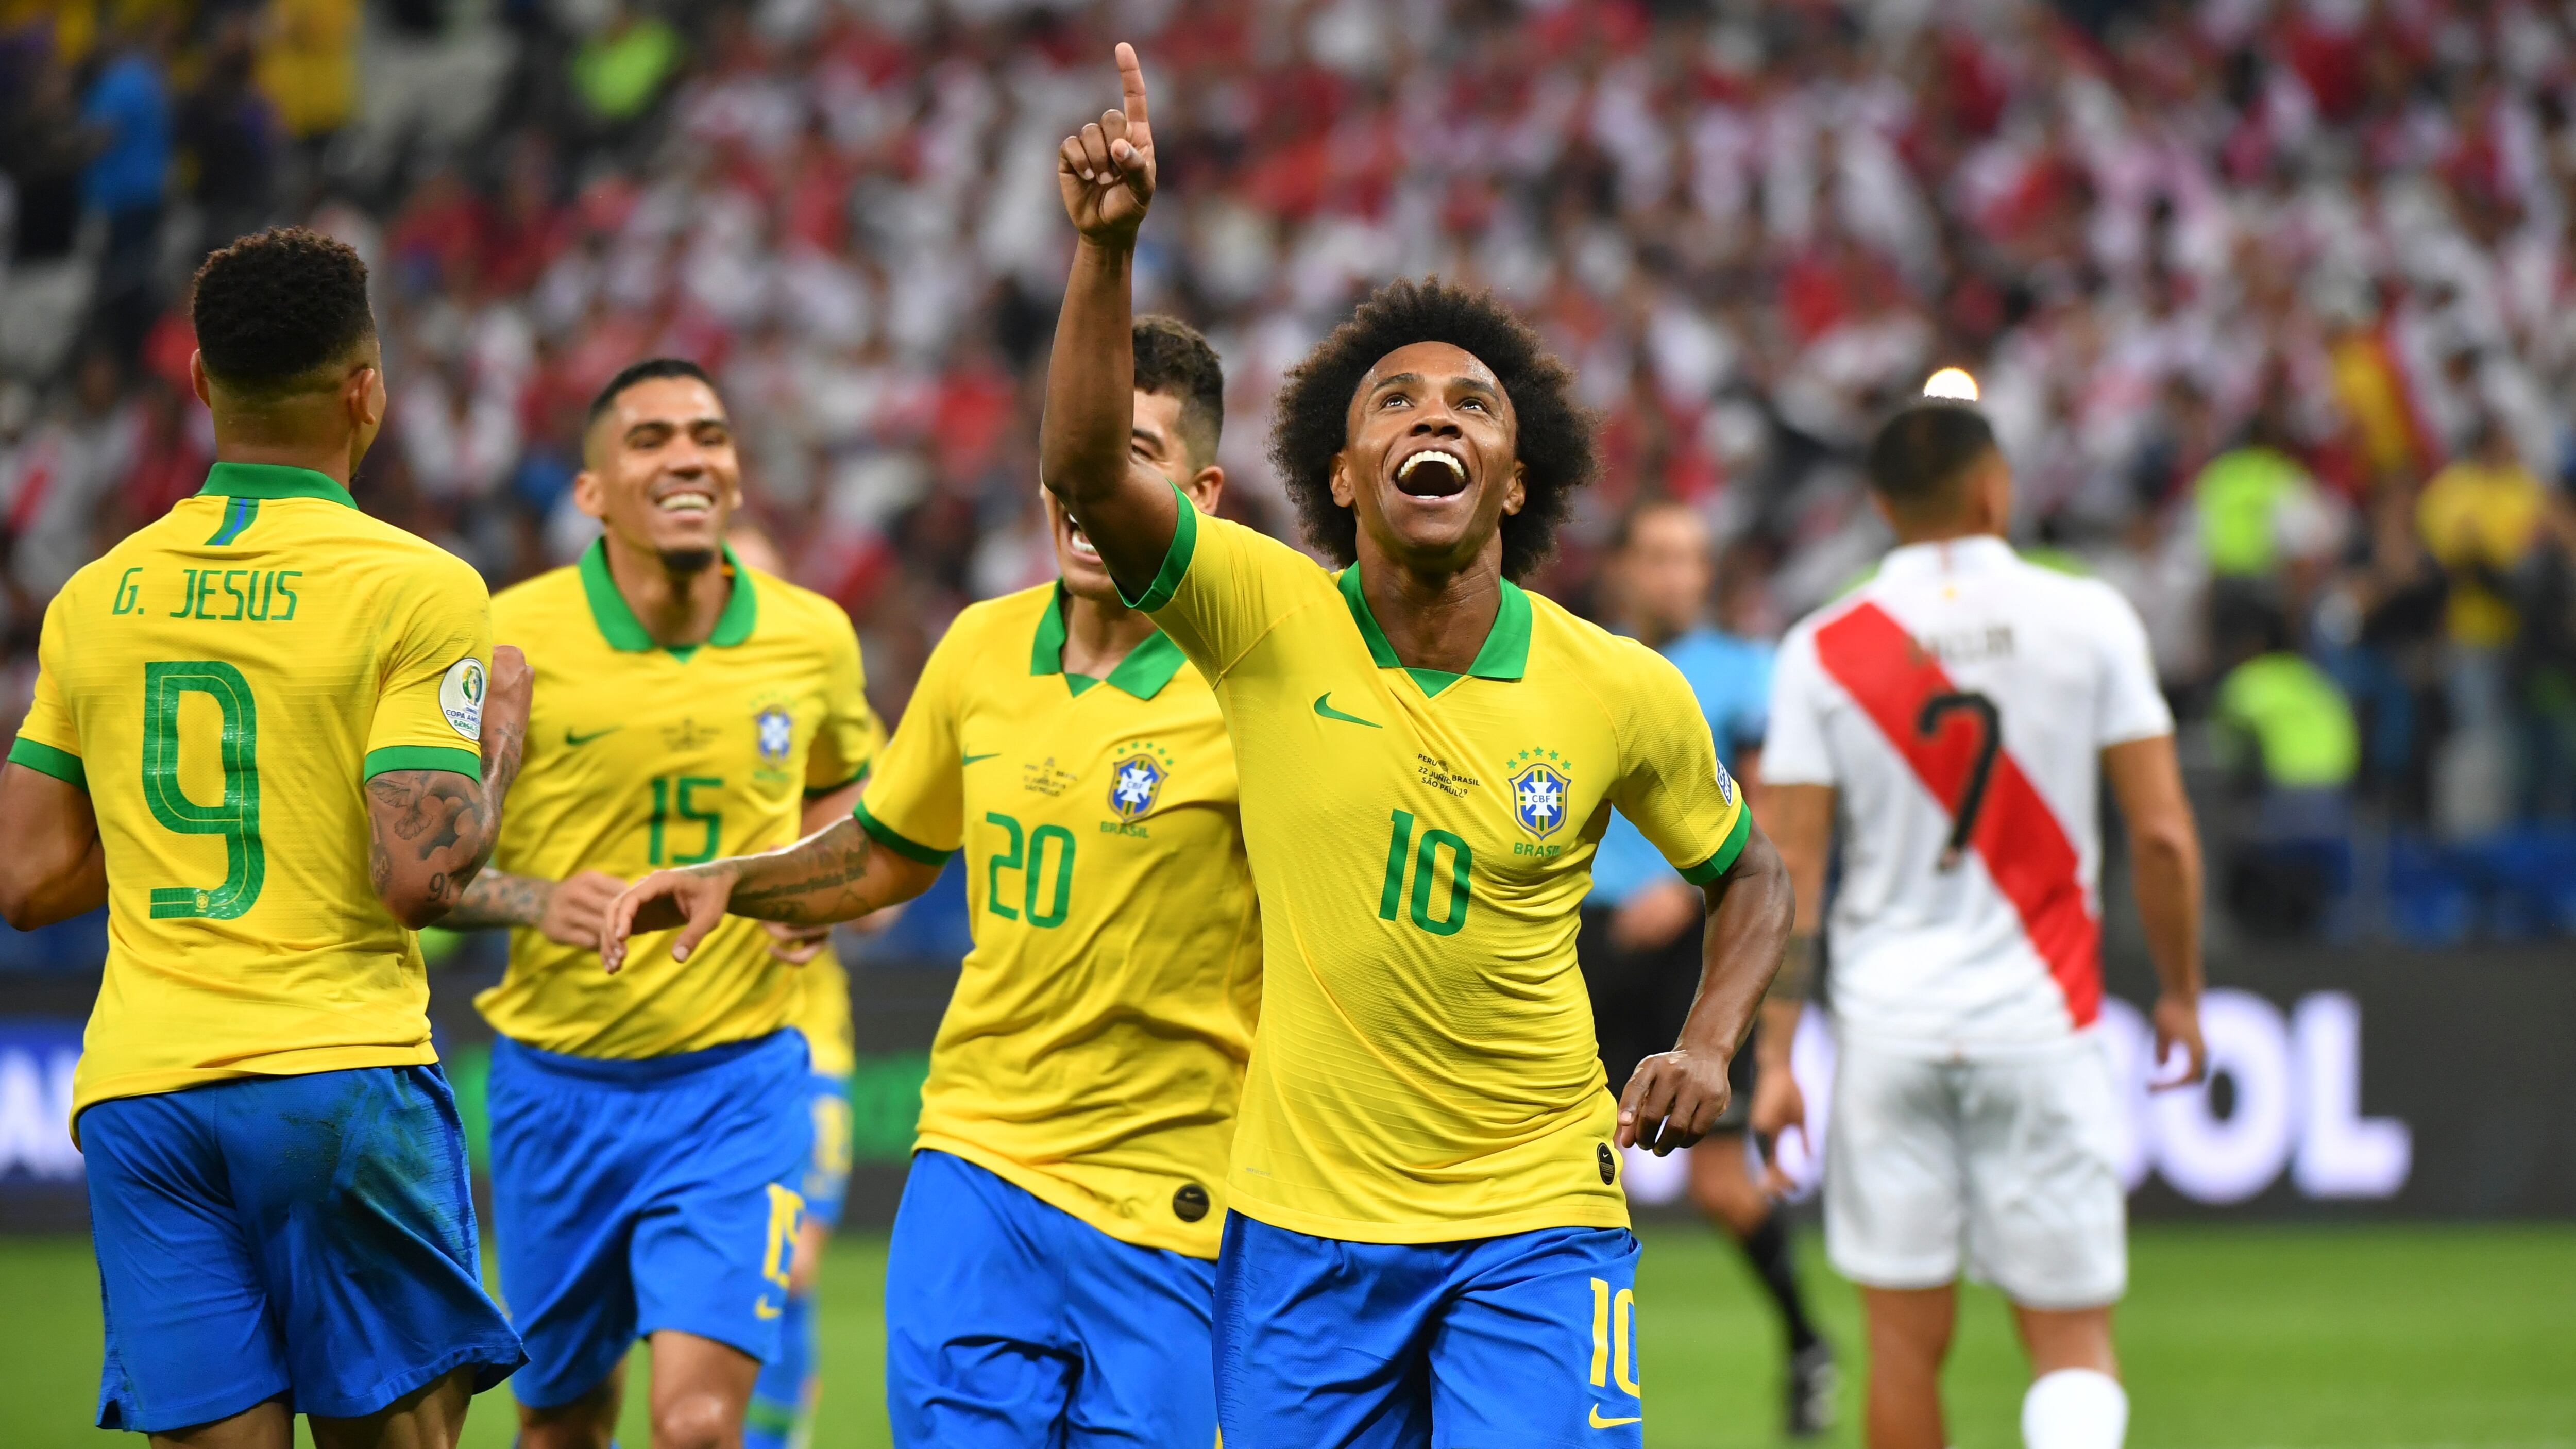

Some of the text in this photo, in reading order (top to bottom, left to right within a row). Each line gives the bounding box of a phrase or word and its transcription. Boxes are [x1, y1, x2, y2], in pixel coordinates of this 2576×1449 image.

[113, 567, 303, 621] G. JESUS
[446, 709, 465, 719] COPA
[1418, 753, 1480, 786] PERU BRASIL
[1418, 766, 1428, 775] 22
[1429, 771, 1452, 784] JUNIO
[1421, 777, 1438, 788] SÃO
[142, 661, 265, 920] 9
[1532, 795, 1551, 803] CBF
[648, 776, 724, 866] 15
[1100, 821, 1149, 838] BRASIL
[985, 810, 1077, 929] 20
[1379, 808, 1473, 937] 10
